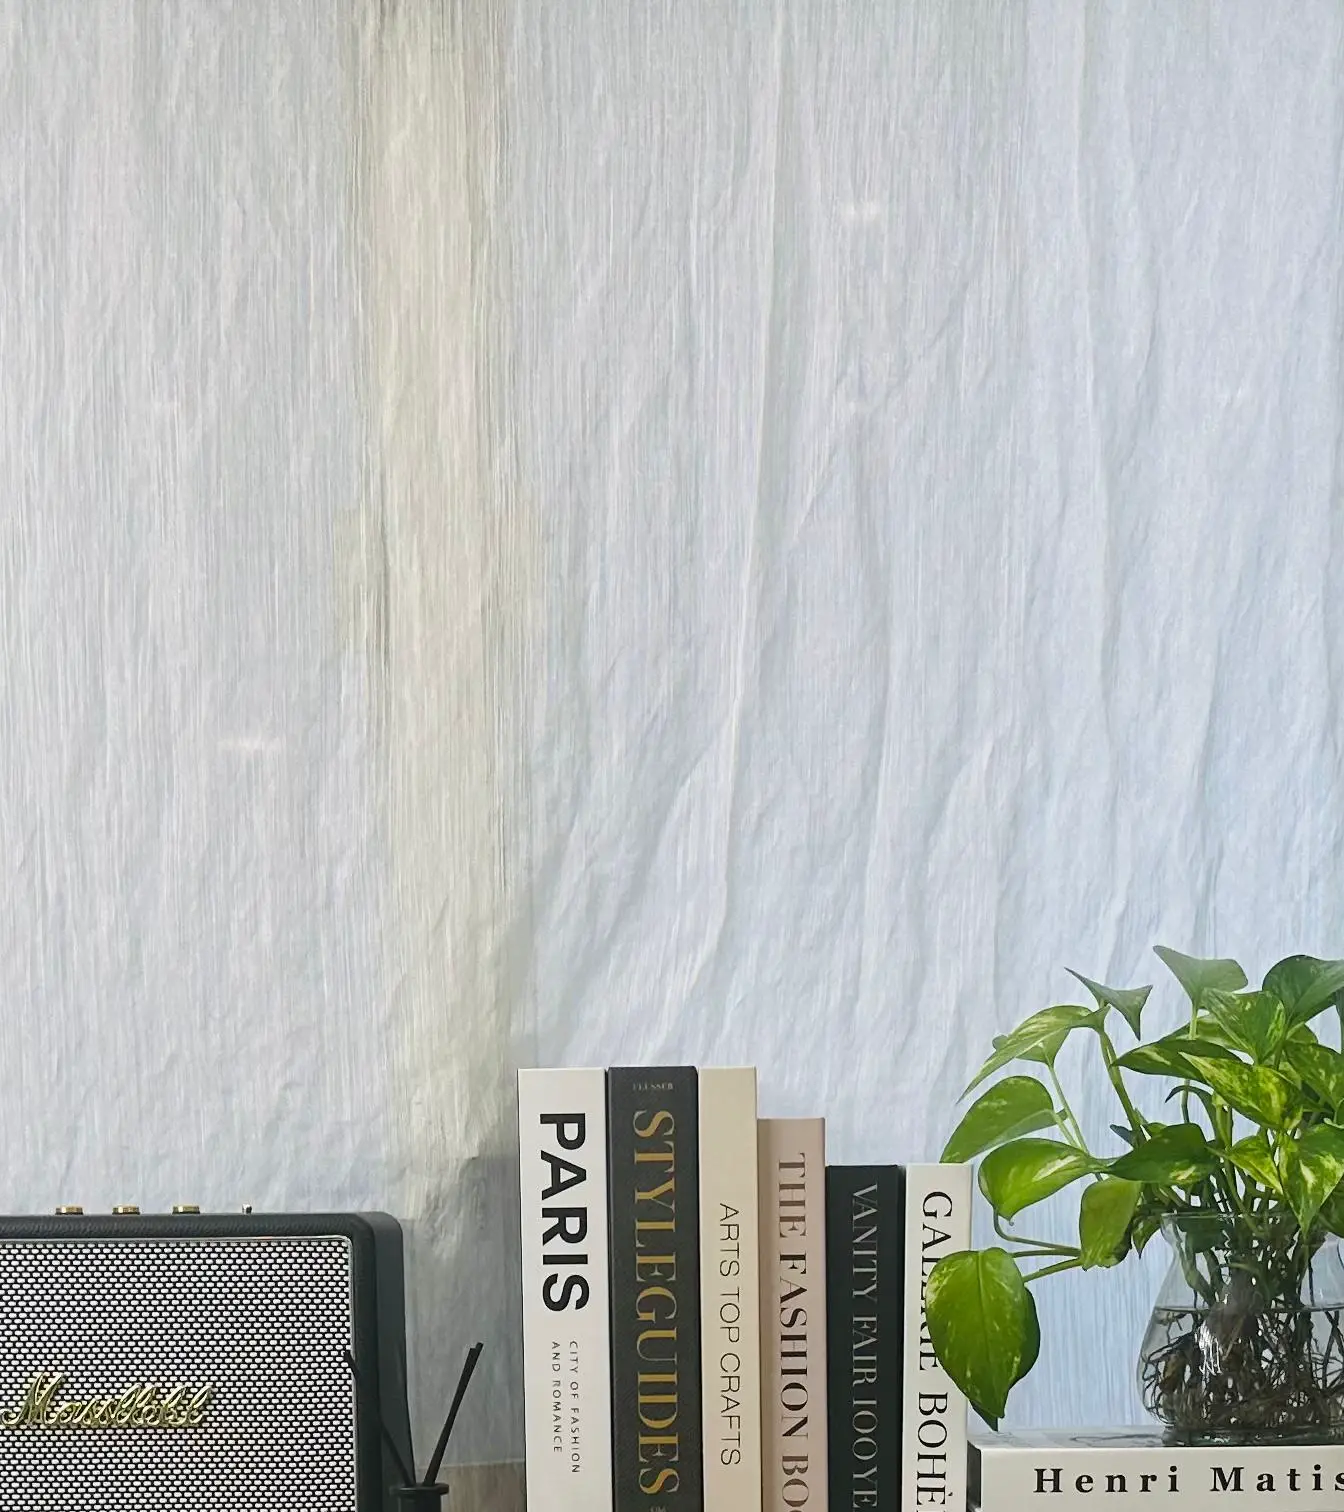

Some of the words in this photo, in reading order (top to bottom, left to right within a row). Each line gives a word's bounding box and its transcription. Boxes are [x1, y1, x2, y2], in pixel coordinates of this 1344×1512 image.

[539, 1111, 590, 1312] PARIS
[777, 1151, 808, 1238] THE
[719, 1202, 740, 1277] ARTS
[852, 1183, 878, 1301] VANITY
[632, 1108, 680, 1495] STYLEGUIDES
[719, 1287, 741, 1344] TOP
[551, 1341, 561, 1372] AND
[569, 1340, 579, 1374] CITY
[779, 1252, 810, 1438] FASHION
[852, 1316, 879, 1387] FAIR
[552, 1380, 563, 1453] ROMANCE
[569, 1381, 580, 1399] OF
[719, 1352, 742, 1466] CRAFTS
[570, 1407, 581, 1473] FASHION
[1032, 1465, 1180, 1494] Henri
